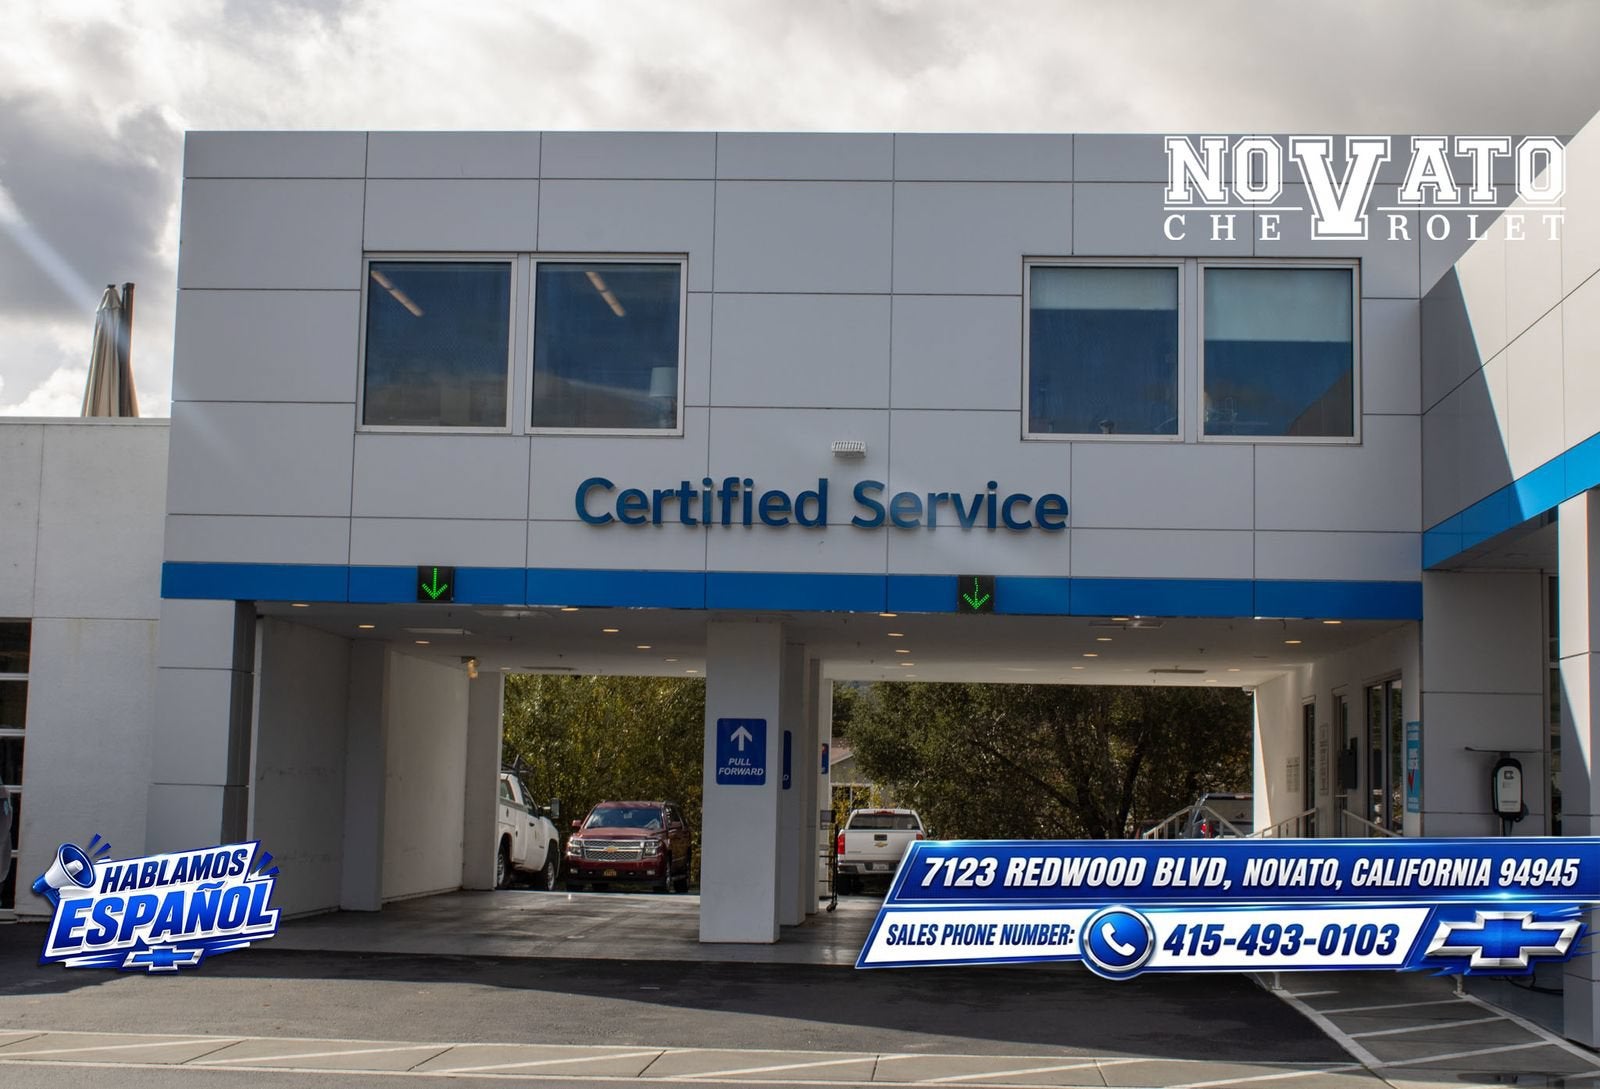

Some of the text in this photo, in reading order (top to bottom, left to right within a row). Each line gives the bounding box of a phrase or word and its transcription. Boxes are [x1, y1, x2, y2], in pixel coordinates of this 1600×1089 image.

[576, 477, 1070, 530] Certified Service
[728, 758, 751, 766] PULL
[719, 767, 764, 775] FORWARD
